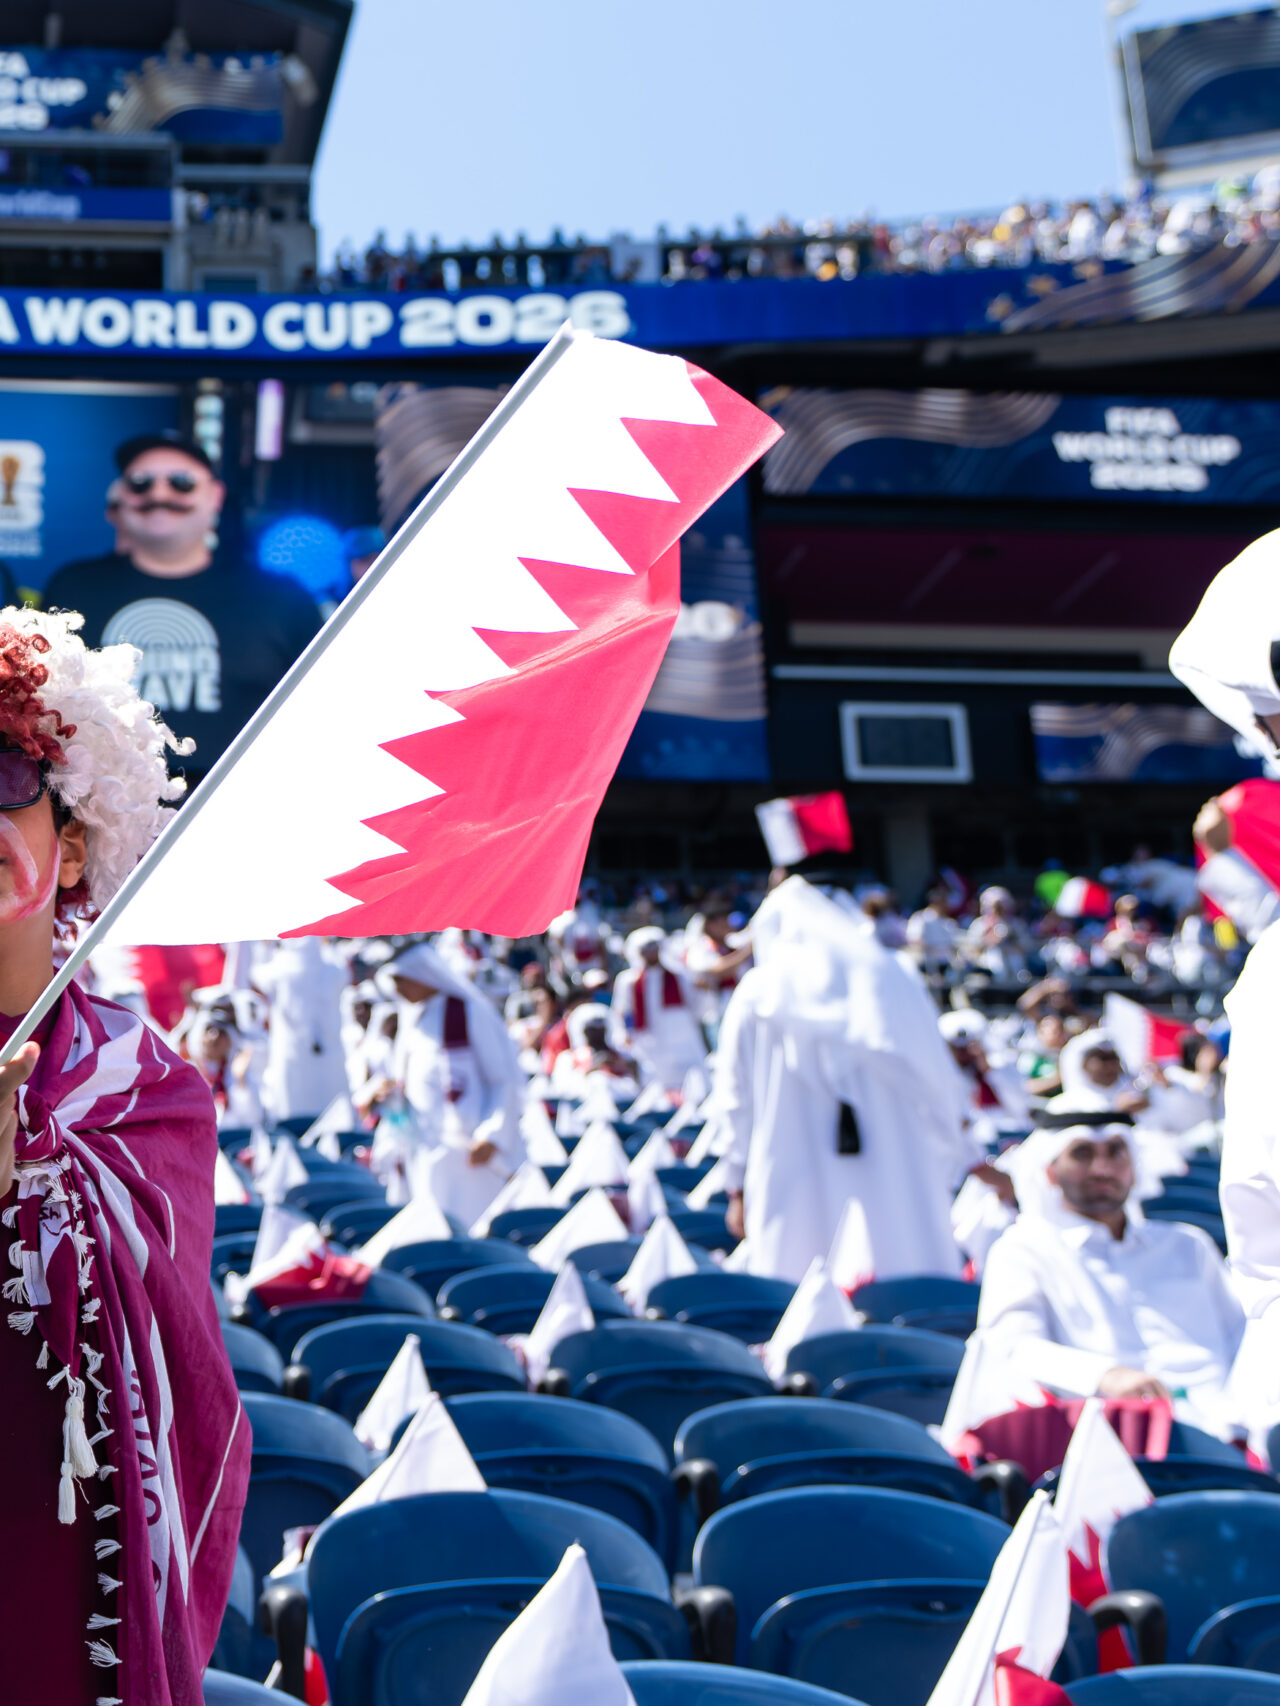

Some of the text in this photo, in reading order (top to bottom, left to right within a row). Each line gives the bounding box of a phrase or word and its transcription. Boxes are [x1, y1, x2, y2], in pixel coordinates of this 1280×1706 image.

[21, 77, 87, 106] CUP
[23, 297, 257, 350] WORLD
[262, 300, 394, 351] CUP
[399, 289, 631, 348] 2026
[1105, 406, 1181, 436] FIFA
[1052, 431, 1241, 466] WORLD CUP
[131, 672, 221, 713] AVE
